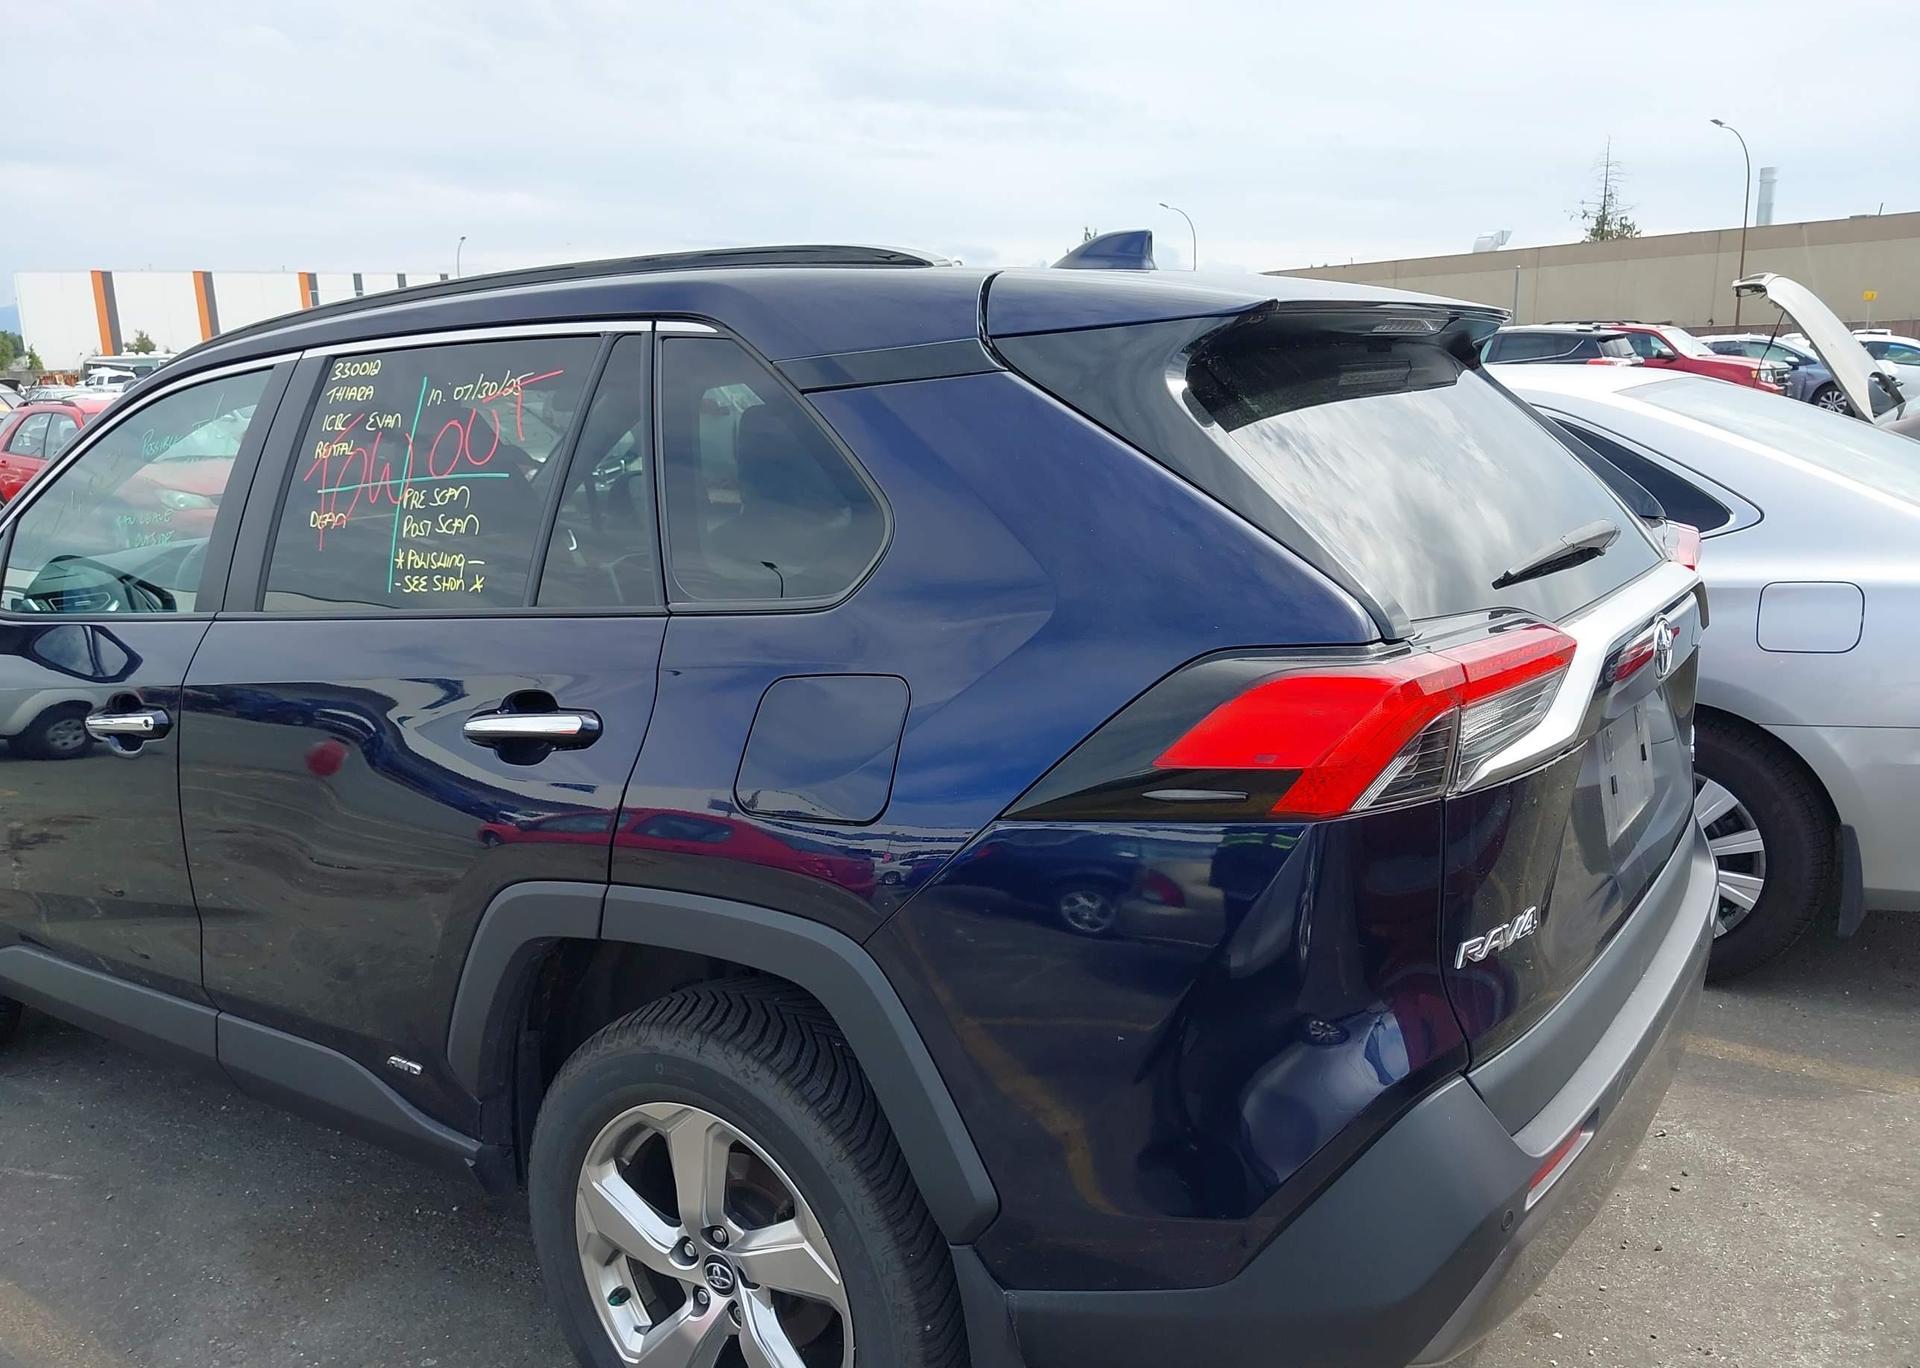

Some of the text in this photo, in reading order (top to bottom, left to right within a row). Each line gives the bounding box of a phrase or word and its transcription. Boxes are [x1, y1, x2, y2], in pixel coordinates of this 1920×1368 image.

[331, 359, 382, 380] 330012
[365, 411, 402, 431] EVAN
[403, 485, 470, 510] PRE SCAN
[403, 513, 479, 538] POST SCAN
[1454, 905, 1538, 970] RAV4
